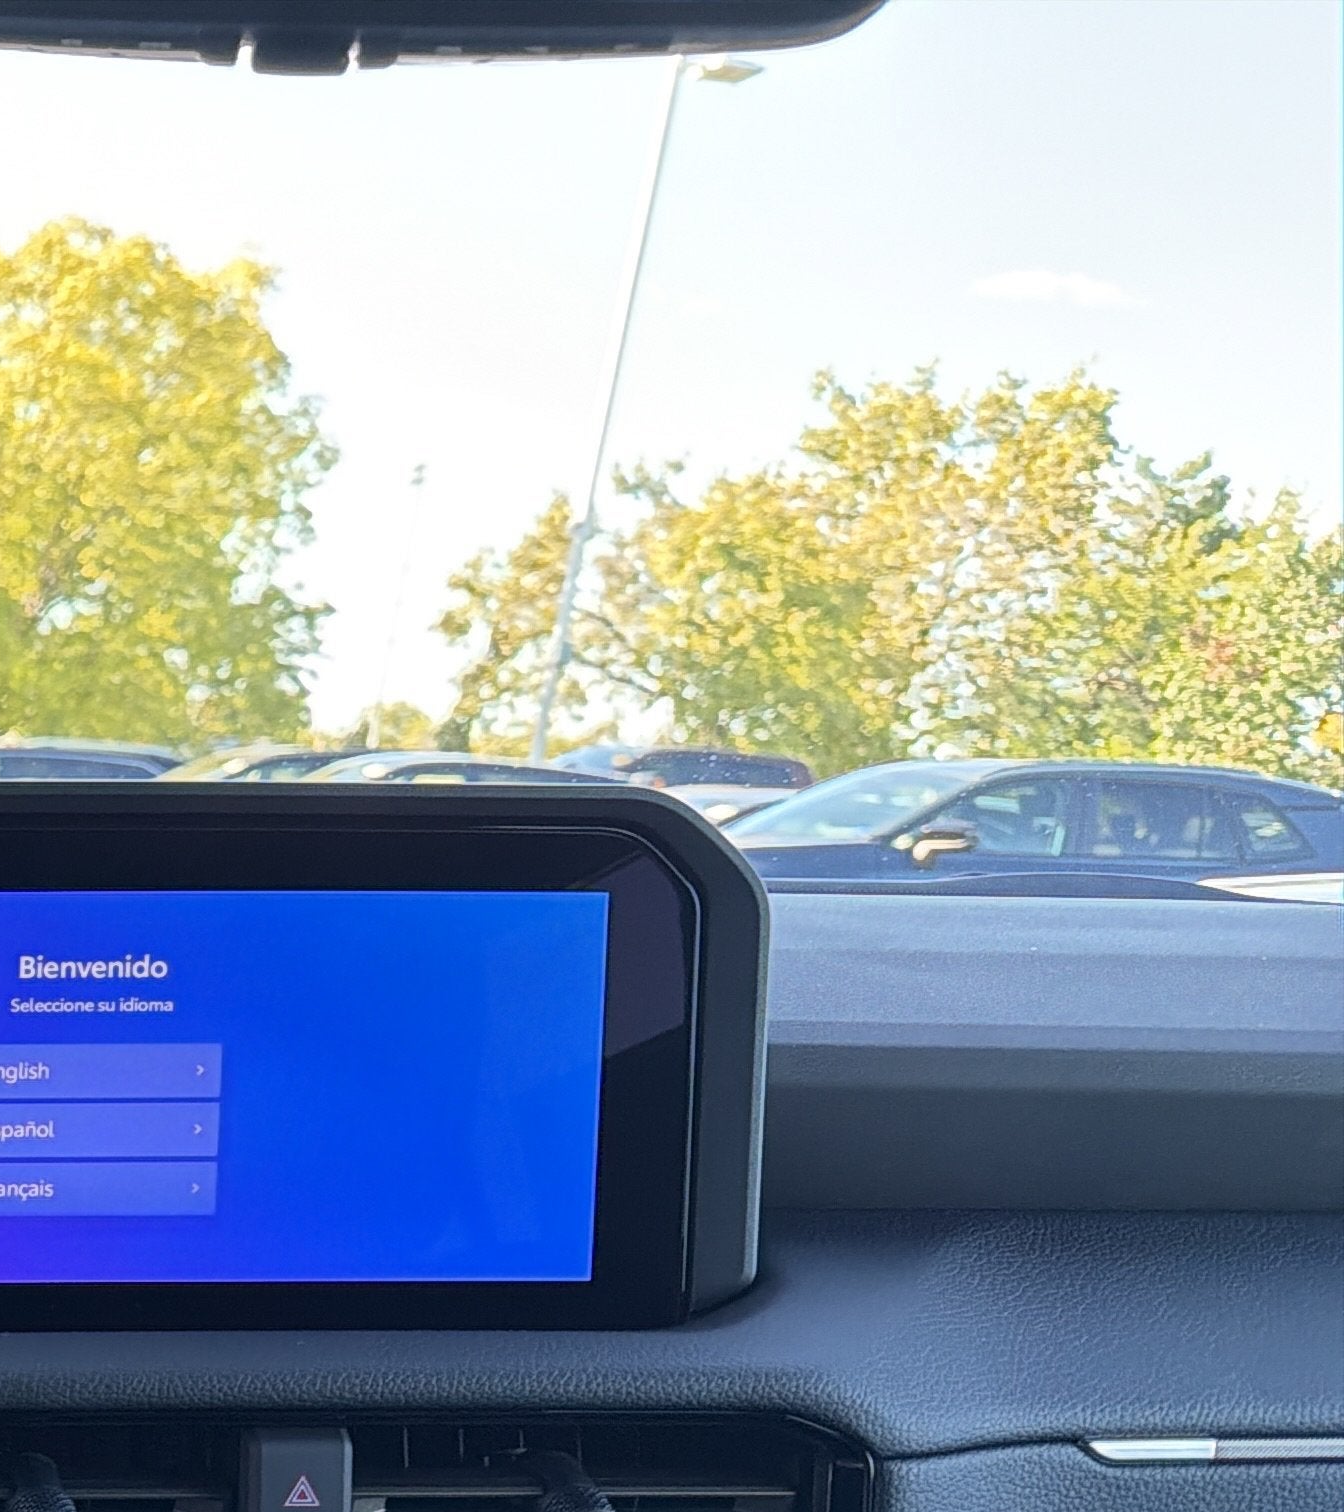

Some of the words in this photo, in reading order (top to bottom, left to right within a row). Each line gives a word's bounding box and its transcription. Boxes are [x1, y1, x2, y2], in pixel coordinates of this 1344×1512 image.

[18, 954, 169, 979] Bienvenido
[10, 998, 95, 1014] Seleccione
[97, 1001, 116, 1013] su
[119, 997, 174, 1013] idioma
